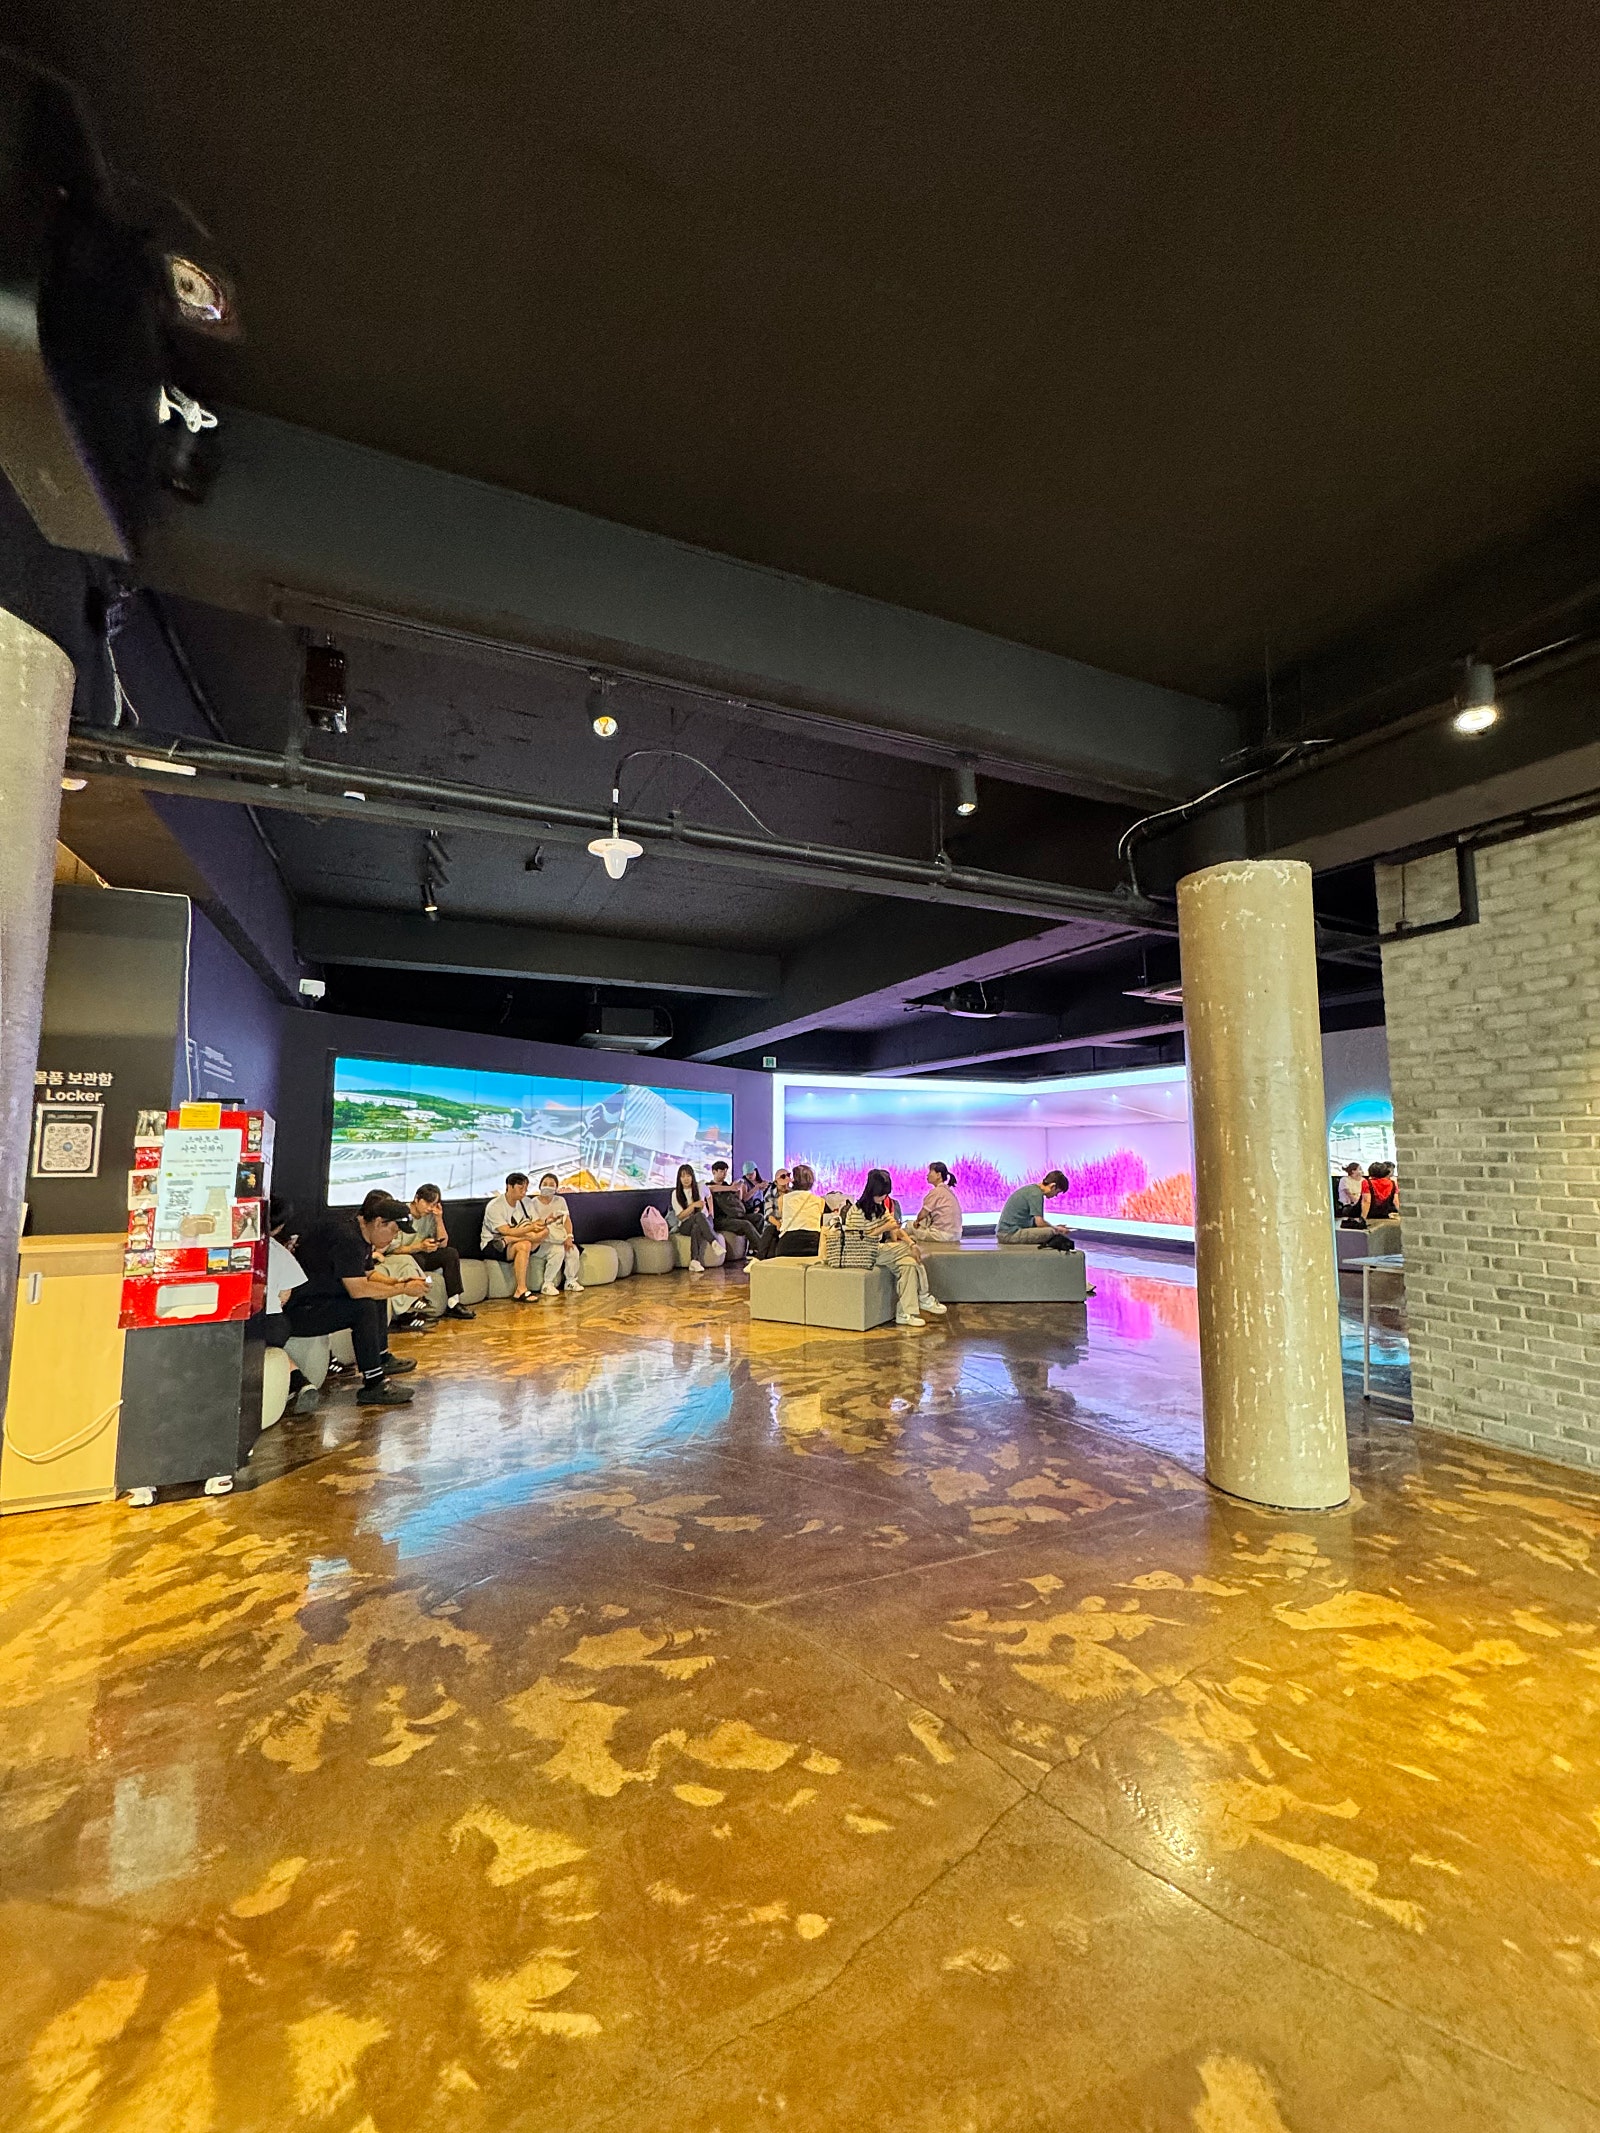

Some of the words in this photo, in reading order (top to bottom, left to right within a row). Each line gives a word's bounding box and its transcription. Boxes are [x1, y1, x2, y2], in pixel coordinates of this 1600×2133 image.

[34, 1070, 64, 1085] 물품
[67, 1072, 113, 1086] 보관함
[46, 1088, 103, 1102] Locker
